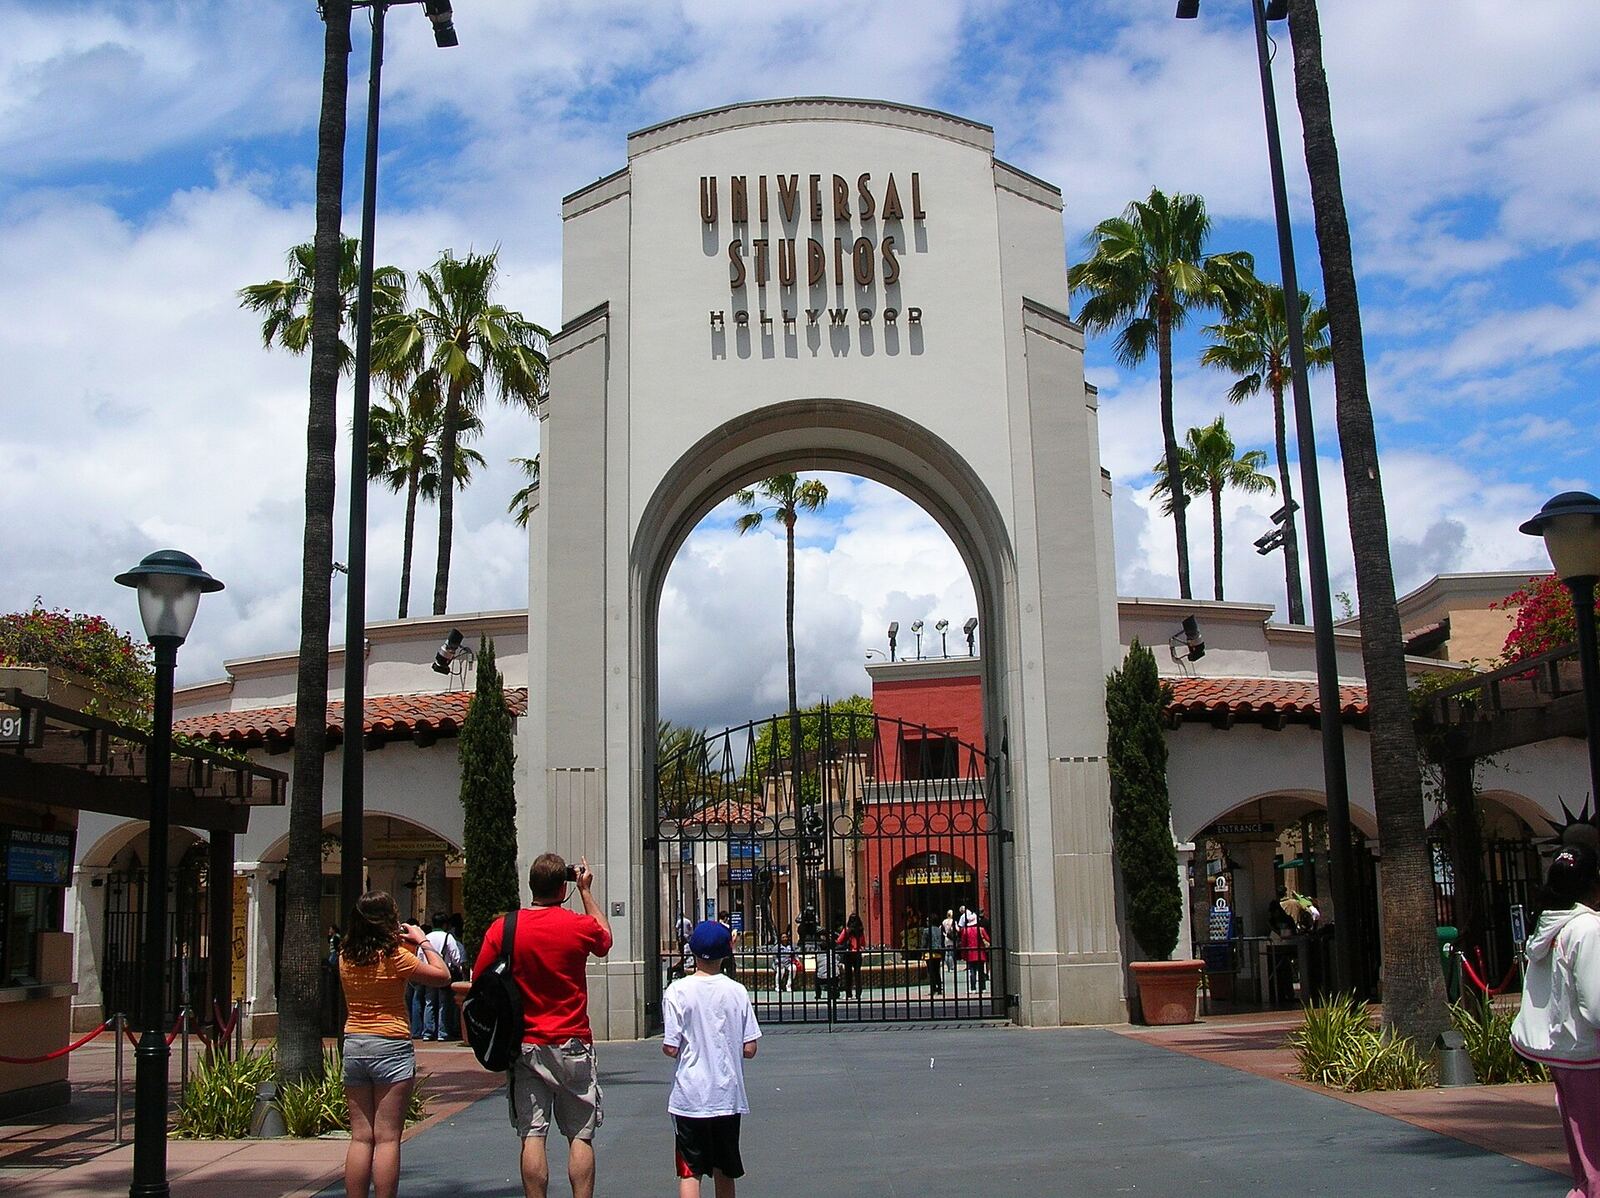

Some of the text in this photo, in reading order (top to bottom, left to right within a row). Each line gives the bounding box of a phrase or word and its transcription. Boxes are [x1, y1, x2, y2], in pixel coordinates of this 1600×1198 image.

[700, 172, 926, 224] UNIVERSAL
[728, 236, 900, 288] STUDIOS
[710, 307, 922, 325] HOLLYWOOD
[0, 717, 21, 737] 91
[11, 830, 70, 846] FRONT OF LINE PASS
[1217, 824, 1262, 833] ENTRANCE
